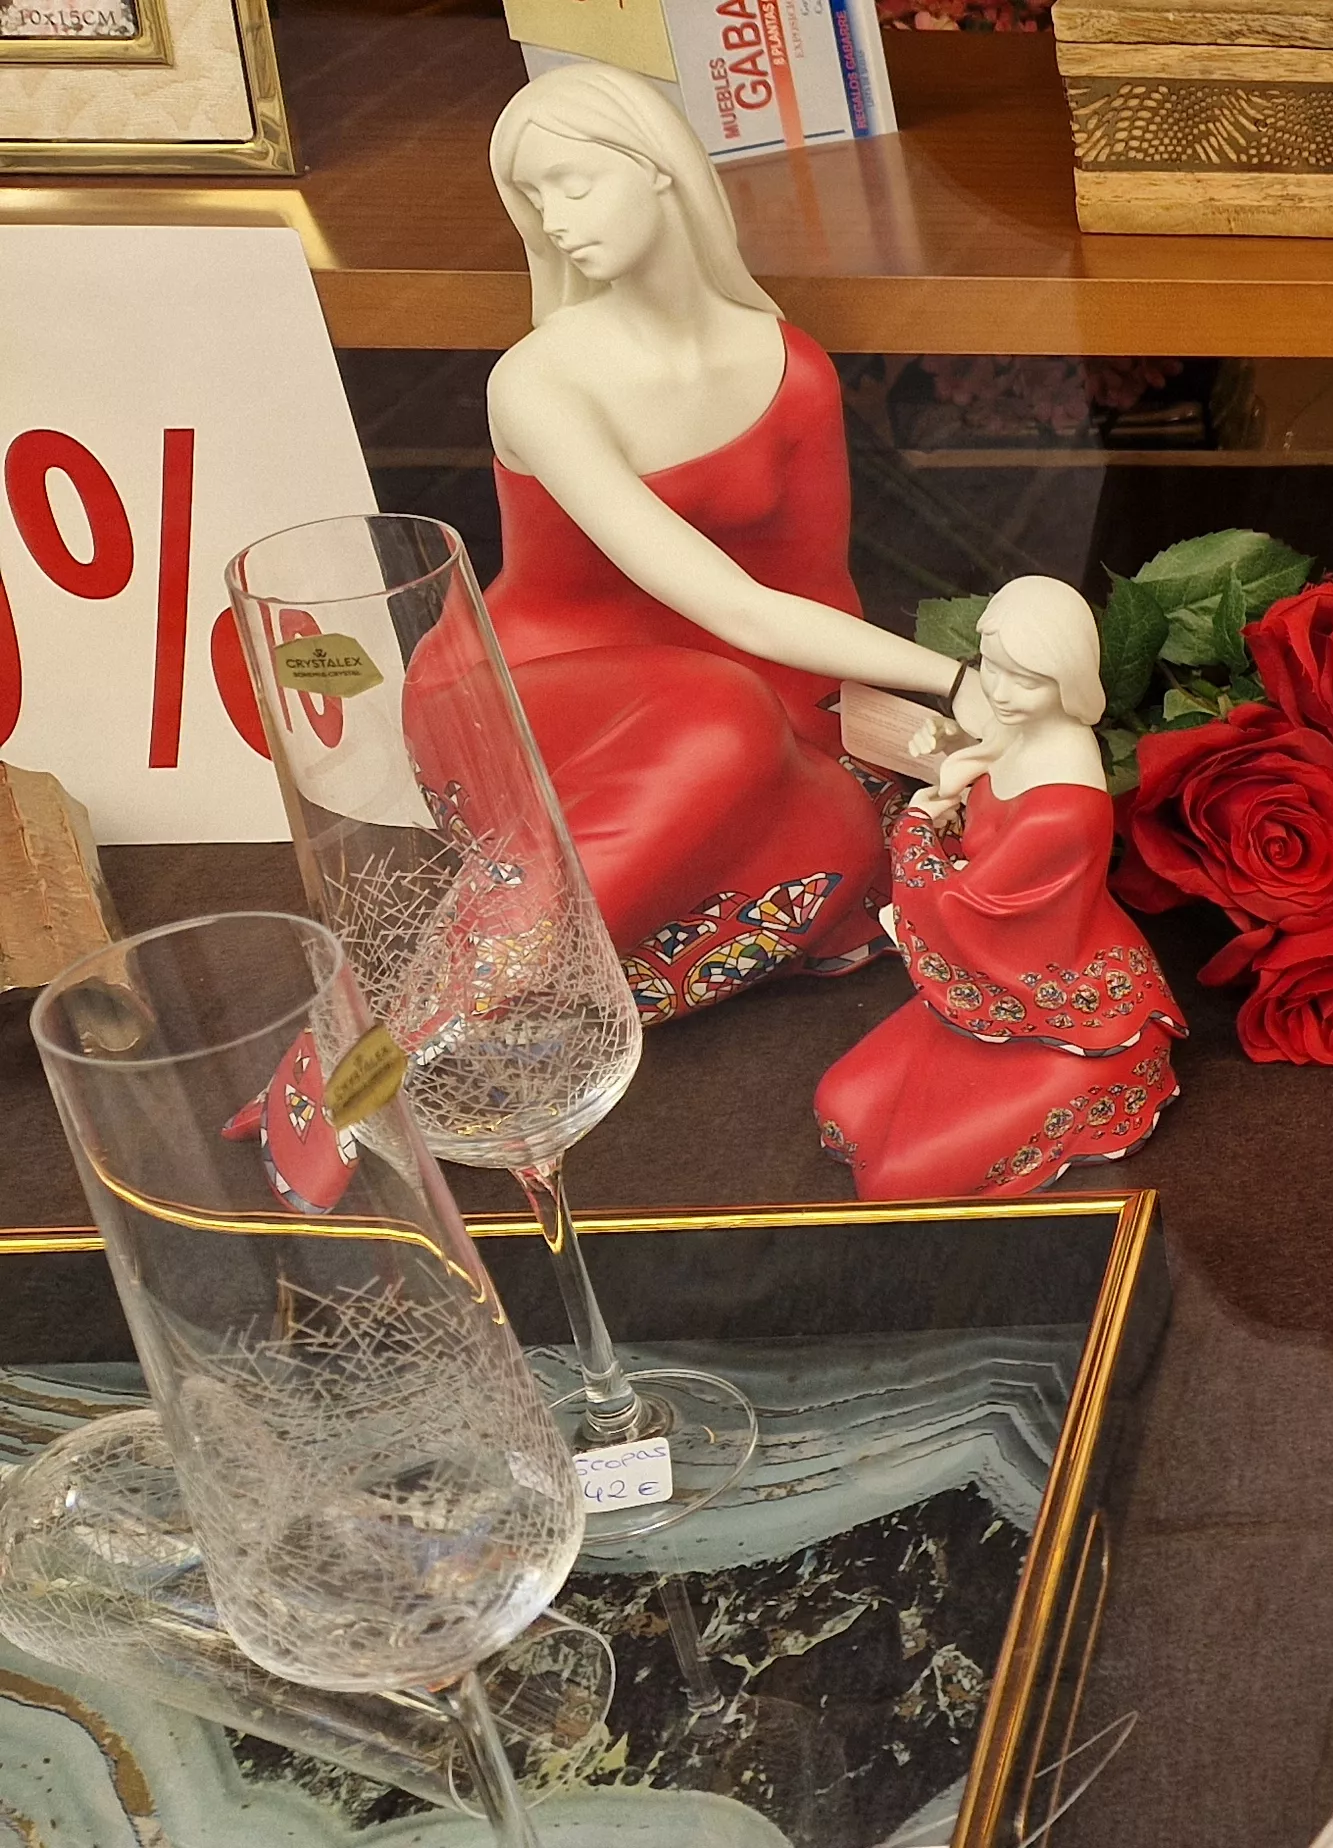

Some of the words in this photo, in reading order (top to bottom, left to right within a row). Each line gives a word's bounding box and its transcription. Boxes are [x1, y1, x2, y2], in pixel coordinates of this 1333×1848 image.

[19, 9, 118, 27] 10x15CM
[762, 2, 787, 58] PLANTAS
[836, 10, 858, 71] GABARRE
[709, 57, 741, 139] MUEBLES
[847, 72, 869, 129] REGALOS
[285, 656, 363, 669] CRYSTALEX
